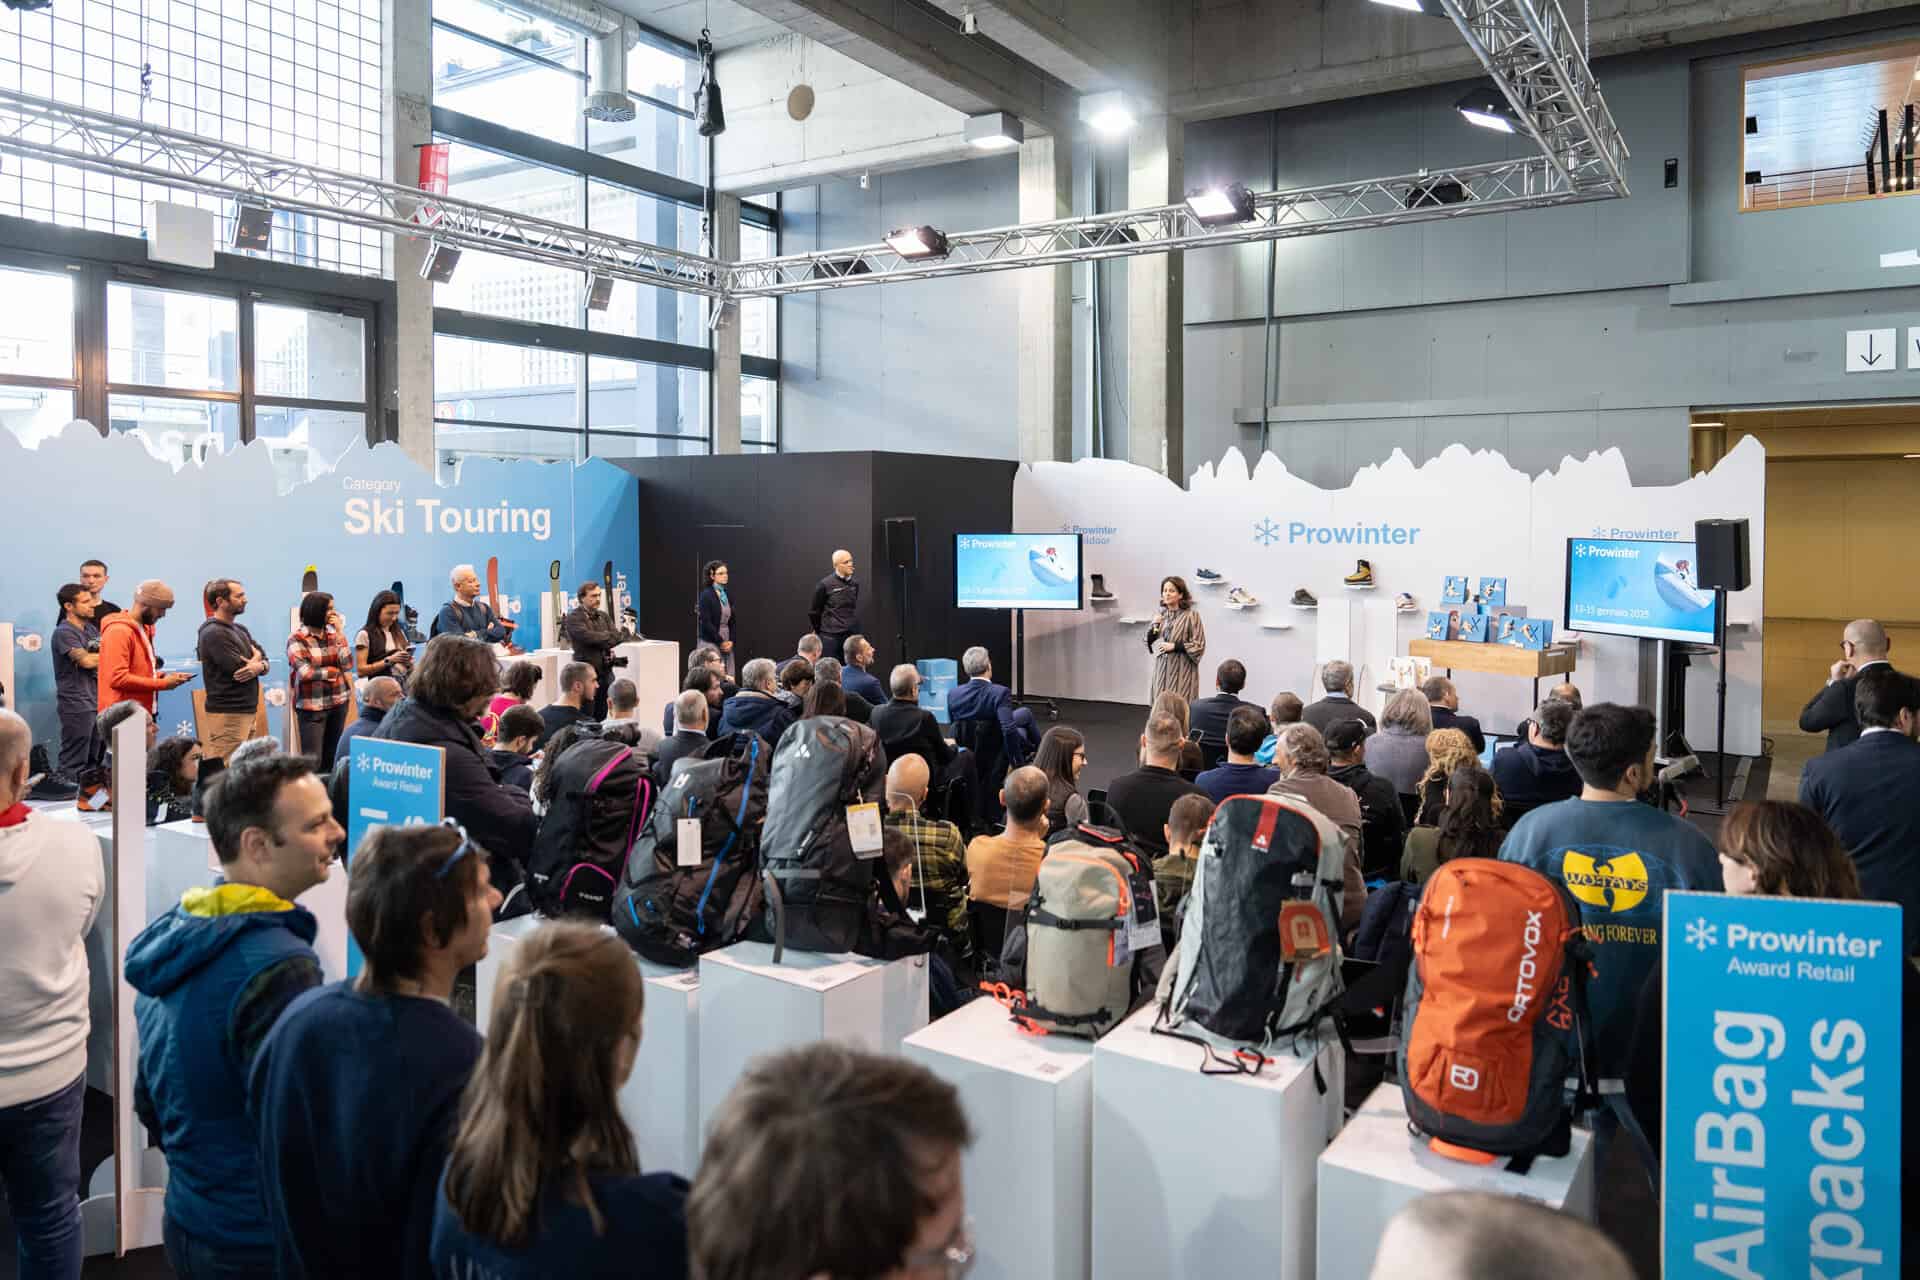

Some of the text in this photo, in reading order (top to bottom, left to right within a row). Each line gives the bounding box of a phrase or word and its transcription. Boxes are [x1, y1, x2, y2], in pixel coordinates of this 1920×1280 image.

[343, 476, 400, 494] Category
[343, 497, 551, 541] Ski Touring
[971, 537, 1017, 549] Prowinter
[1288, 521, 1421, 545] Prowinter
[1610, 528, 1680, 539] Prowinter
[1588, 545, 1640, 559] Prowinter
[373, 757, 433, 779] Prowinter
[1606, 924, 1657, 944] FOREVER
[1727, 923, 1882, 959] Prowinter
[1507, 910, 1543, 1023] ORTOVOX
[1727, 956, 1855, 982] Award Retail
[1693, 1009, 1787, 1280] AirBag
